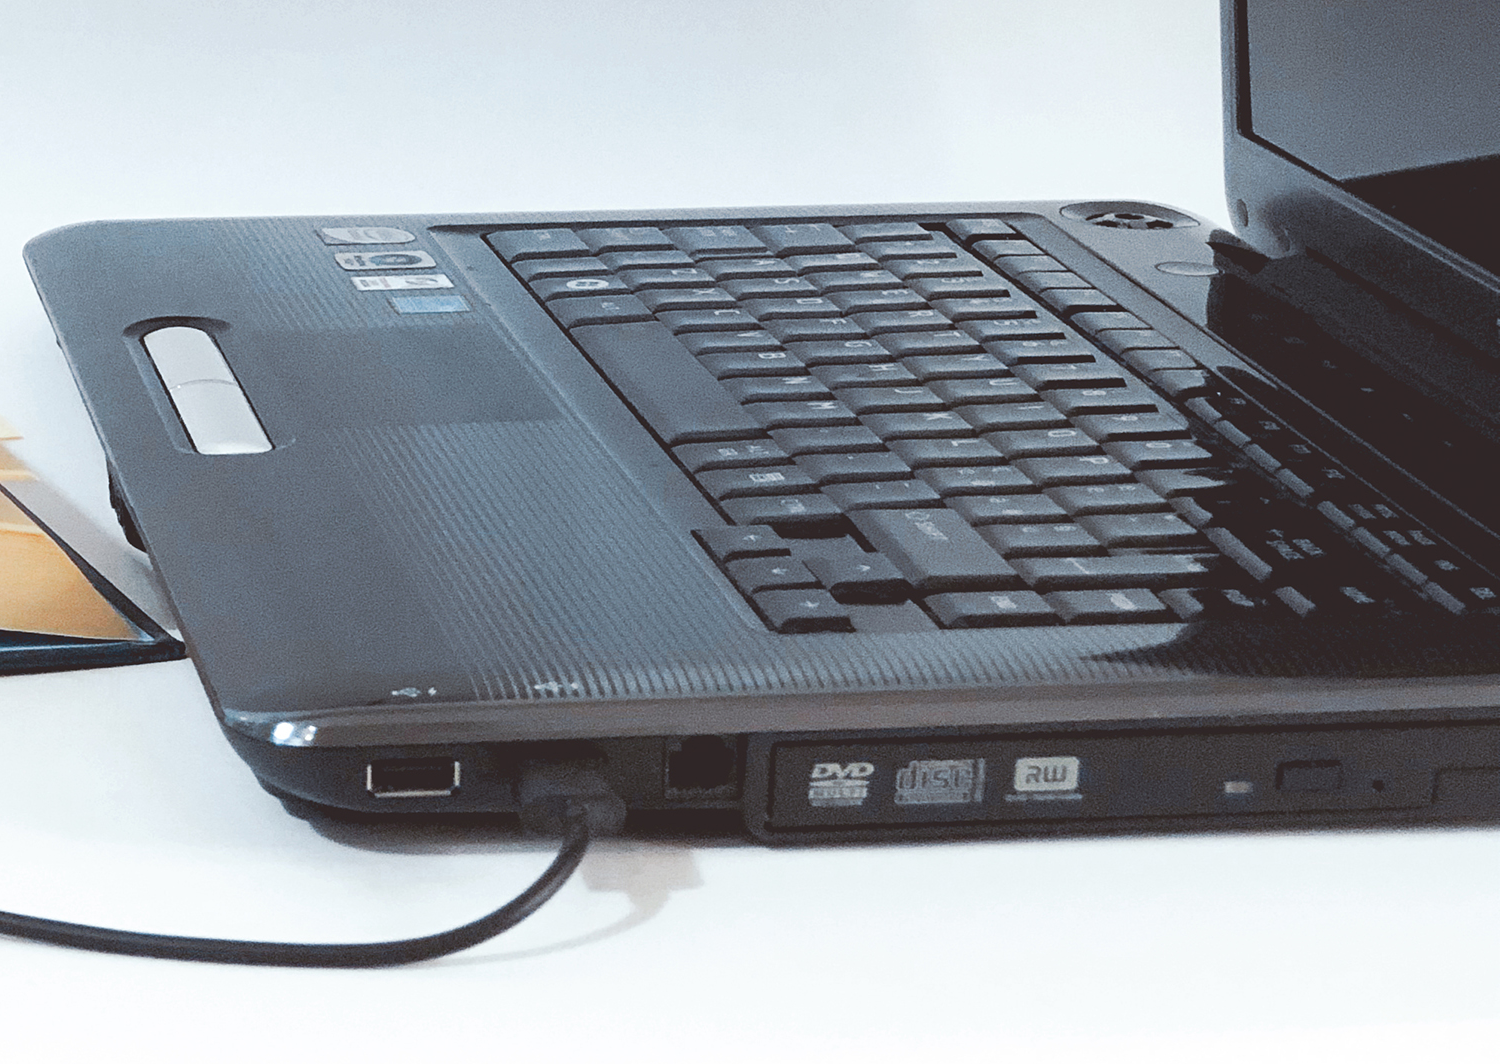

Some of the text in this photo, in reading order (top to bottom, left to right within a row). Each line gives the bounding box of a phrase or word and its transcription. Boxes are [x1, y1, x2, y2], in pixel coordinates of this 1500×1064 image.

[844, 340, 872, 348] G
[962, 354, 991, 362] Y
[868, 363, 898, 372] H
[782, 376, 811, 384] N
[806, 401, 838, 410] M
[924, 412, 953, 421] K
[1079, 456, 1109, 464] P
[810, 762, 875, 778] DVD
[1025, 764, 1068, 784] RW
